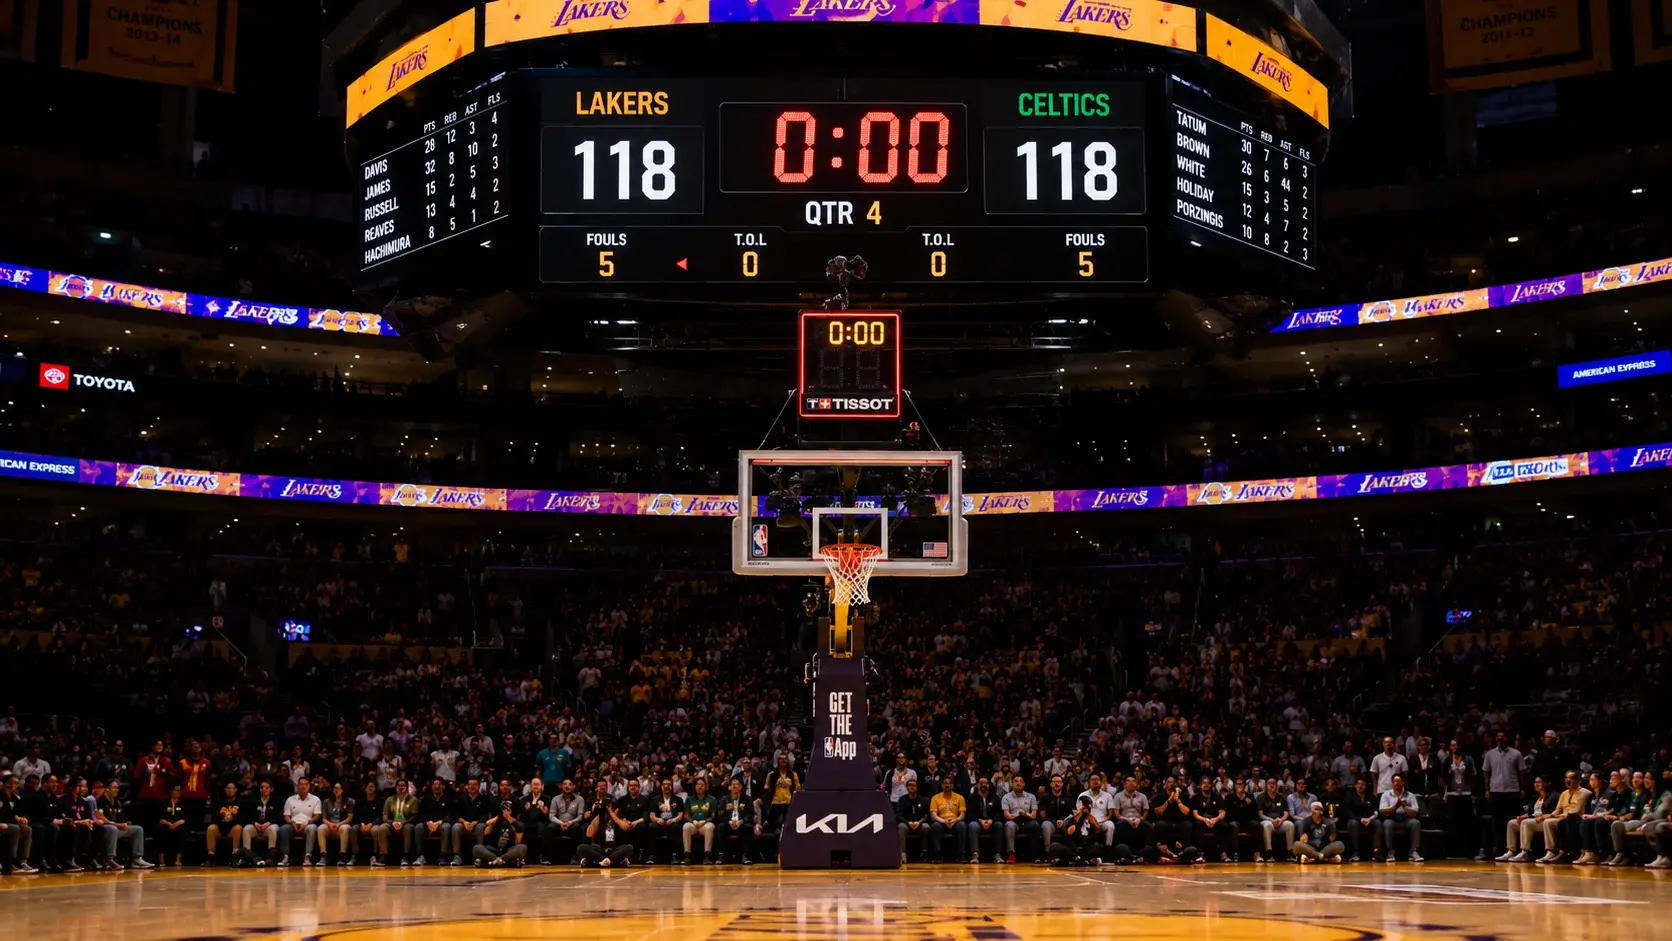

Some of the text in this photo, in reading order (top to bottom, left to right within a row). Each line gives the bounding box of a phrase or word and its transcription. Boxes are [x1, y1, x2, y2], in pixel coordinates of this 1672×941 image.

[107, 7, 202, 34] CHAMPIONS
[551, 0, 630, 27] LAKERS
[1056, 0, 1133, 30] LAKERS
[1460, 6, 1557, 31] CHAMPIONS
[126, 27, 180, 45] 2013-14
[1482, 27, 1535, 44] 2011-12
[386, 49, 428, 91] LAKERS
[1251, 51, 1293, 92] LAKERS
[423, 93, 500, 134] PTS REB AST FLS
[577, 91, 668, 115] LAKERS
[1019, 93, 1109, 116] CELTICS
[365, 112, 497, 180] DAVIS 28 12 3 4
[773, 111, 950, 184] 0:00
[1177, 110, 1308, 178] TATUM 30 7 6 3
[1241, 121, 1310, 161] PTS REB AST FLS
[365, 134, 498, 201] JAMES 32 8 10 2
[575, 141, 675, 200] 118
[1017, 142, 1117, 200] 118
[1177, 132, 1308, 199] BROWN 26 6 44 2
[365, 156, 498, 222] RUSSELL 15 2 5 3
[1177, 154, 1308, 220] WHITE 15 3 5 2
[365, 178, 498, 243] REAVES 13 4 4 2
[806, 201, 882, 226] QTR 4
[1177, 177, 1308, 240] HOLIDAY 12 4 7 2
[365, 200, 499, 264] HACHIMURA 8 5 1 2
[587, 233, 626, 245] FOULS
[734, 233, 767, 245] T.O.L
[922, 233, 954, 245] T.O.L
[1066, 233, 1105, 246] FOULS
[1177, 199, 1308, 261] PORZINGIS 10 8 2 3
[600, 251, 614, 276] 5
[743, 251, 758, 276] 0
[931, 251, 946, 277] 0
[1079, 252, 1093, 276] 5
[1511, 280, 1566, 302] LAKERS
[829, 321, 885, 345] 0:00
[73, 373, 135, 392] TOYOTA
[832, 398, 893, 410] TISSOT
[29, 461, 76, 475] EXPRESS
[280, 479, 342, 498] LAKERS
[429, 488, 485, 507] LAKERS
[1092, 490, 1148, 508] LAKERS
[685, 497, 738, 514] LAKERS
[979, 495, 1031, 512] LAKERS
[829, 692, 853, 713] GET
[829, 714, 853, 736] THE
[834, 738, 857, 761] App
[796, 813, 884, 834] KIA
